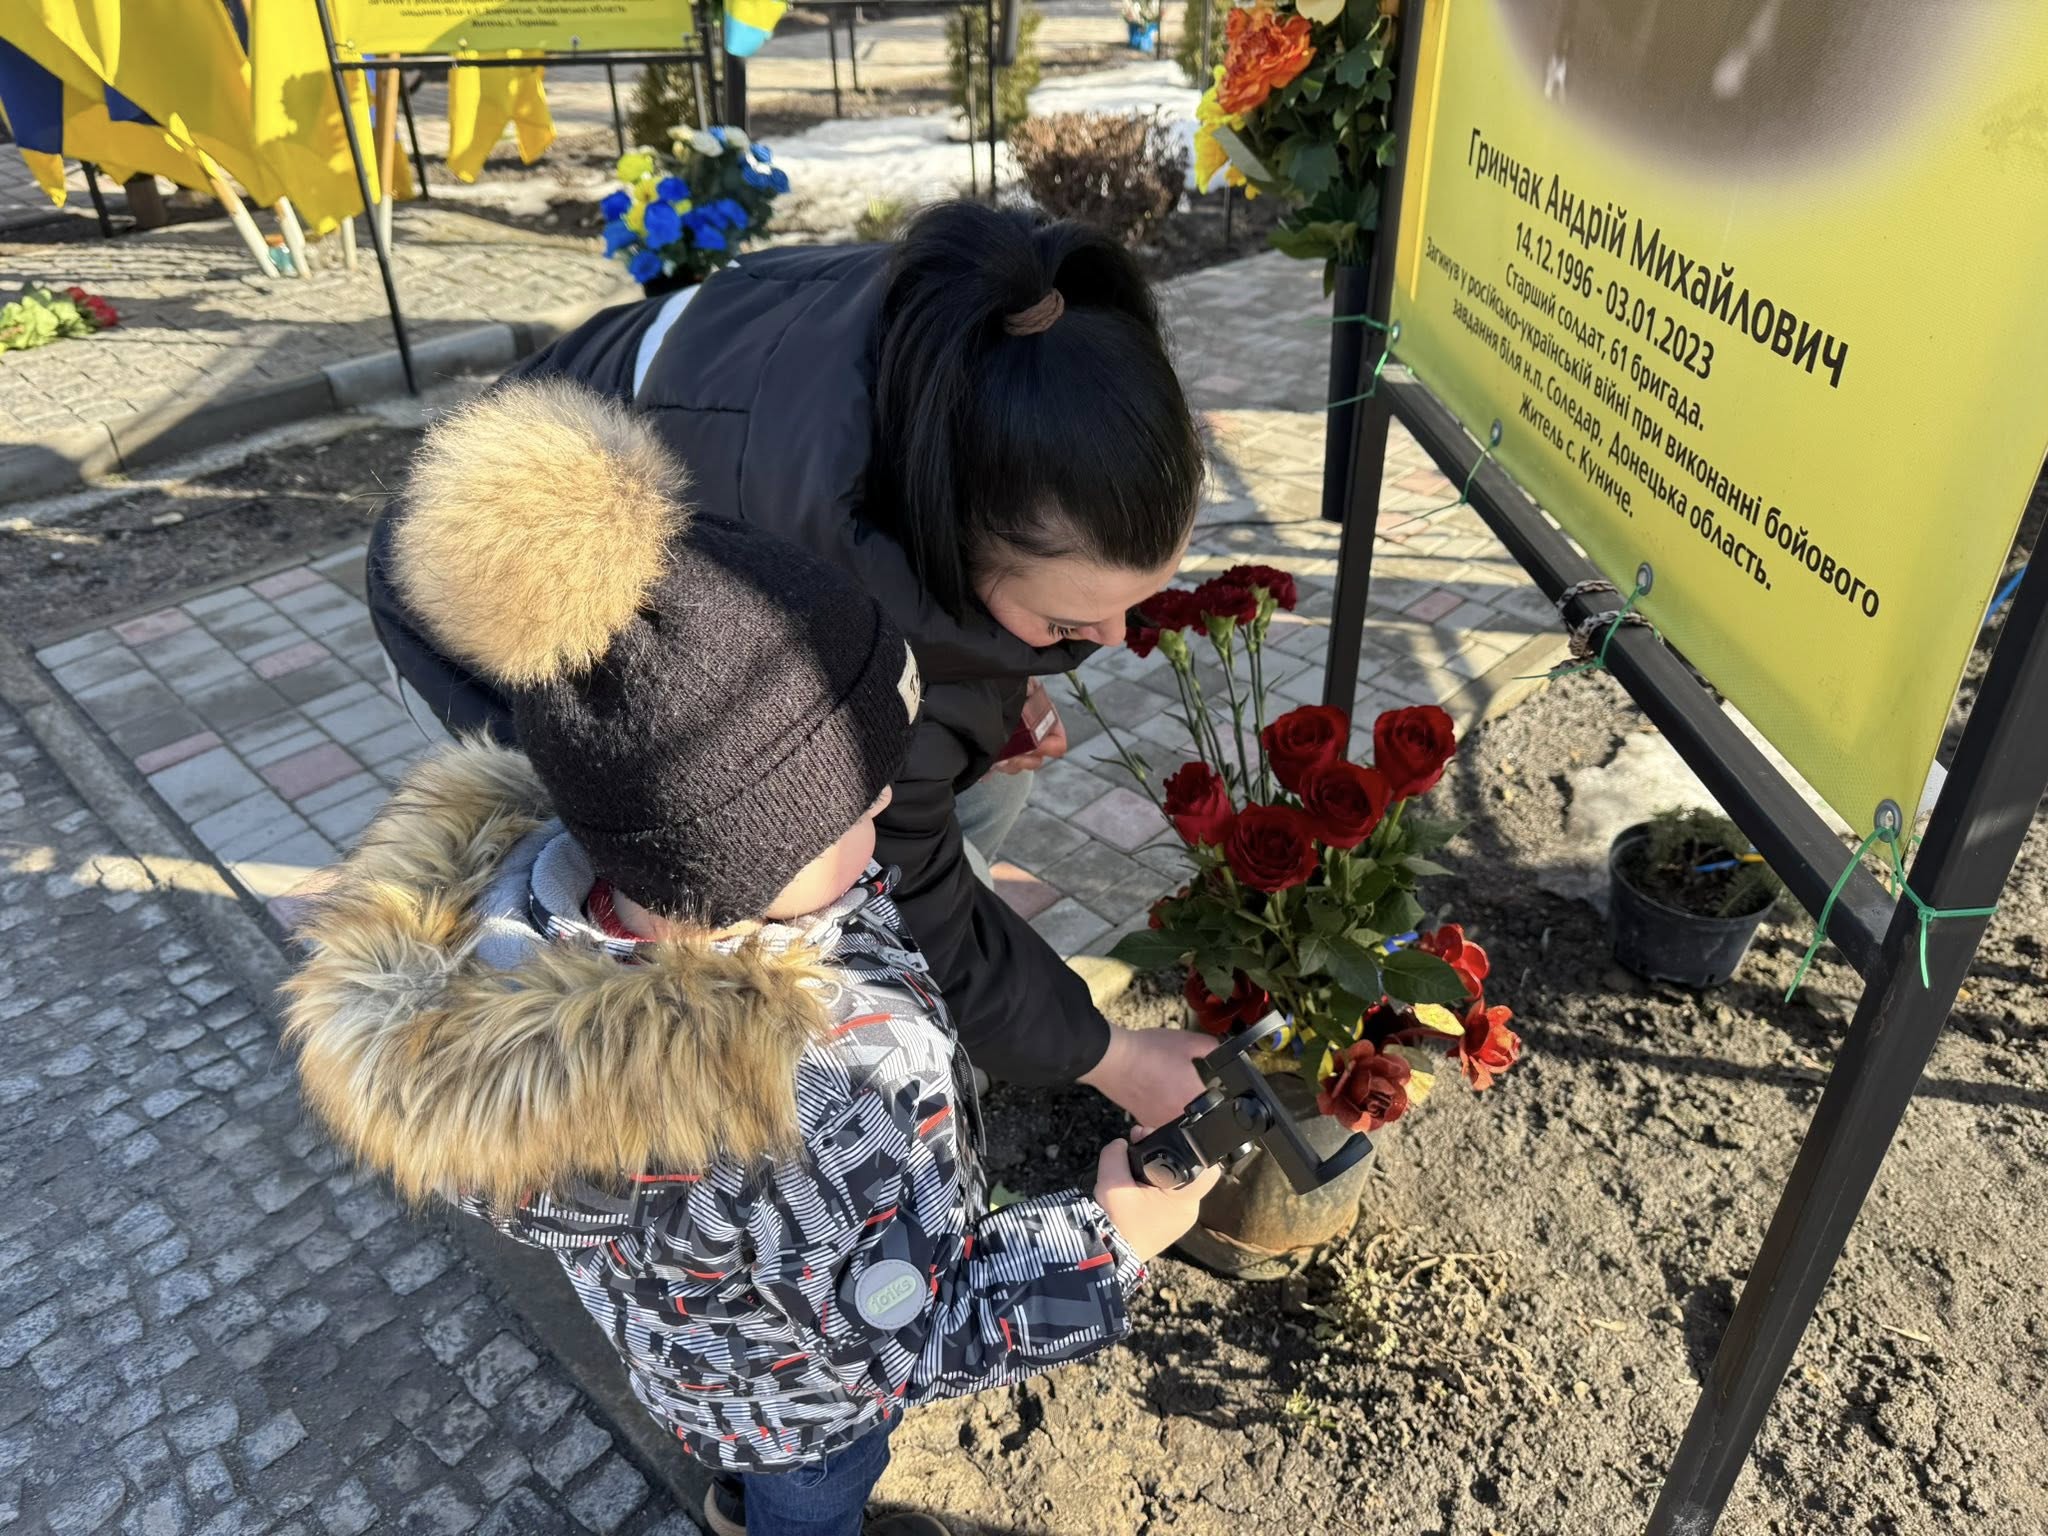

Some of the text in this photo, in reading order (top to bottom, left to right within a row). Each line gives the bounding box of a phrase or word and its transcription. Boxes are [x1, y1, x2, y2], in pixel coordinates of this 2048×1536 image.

[1468, 127, 1849, 389] Гринчак Андрій Михайлович
[1506, 263, 1705, 432] Старший солдат, 61 бригада.
[1516, 222, 1594, 298] 14.12.1996
[1605, 280, 1715, 380] 03.01.2023
[1452, 298, 1772, 591] завдання біля н.п. Соледар, Донецька область.
[1460, 268, 1468, 291] у
[1467, 275, 1593, 390] російсько-українській
[1594, 376, 1632, 421] війні
[1631, 406, 1664, 449] при
[1664, 433, 1763, 526] виконанні
[1764, 506, 1880, 618] бойового
[1518, 393, 1633, 518] Житель с. Куниче.
